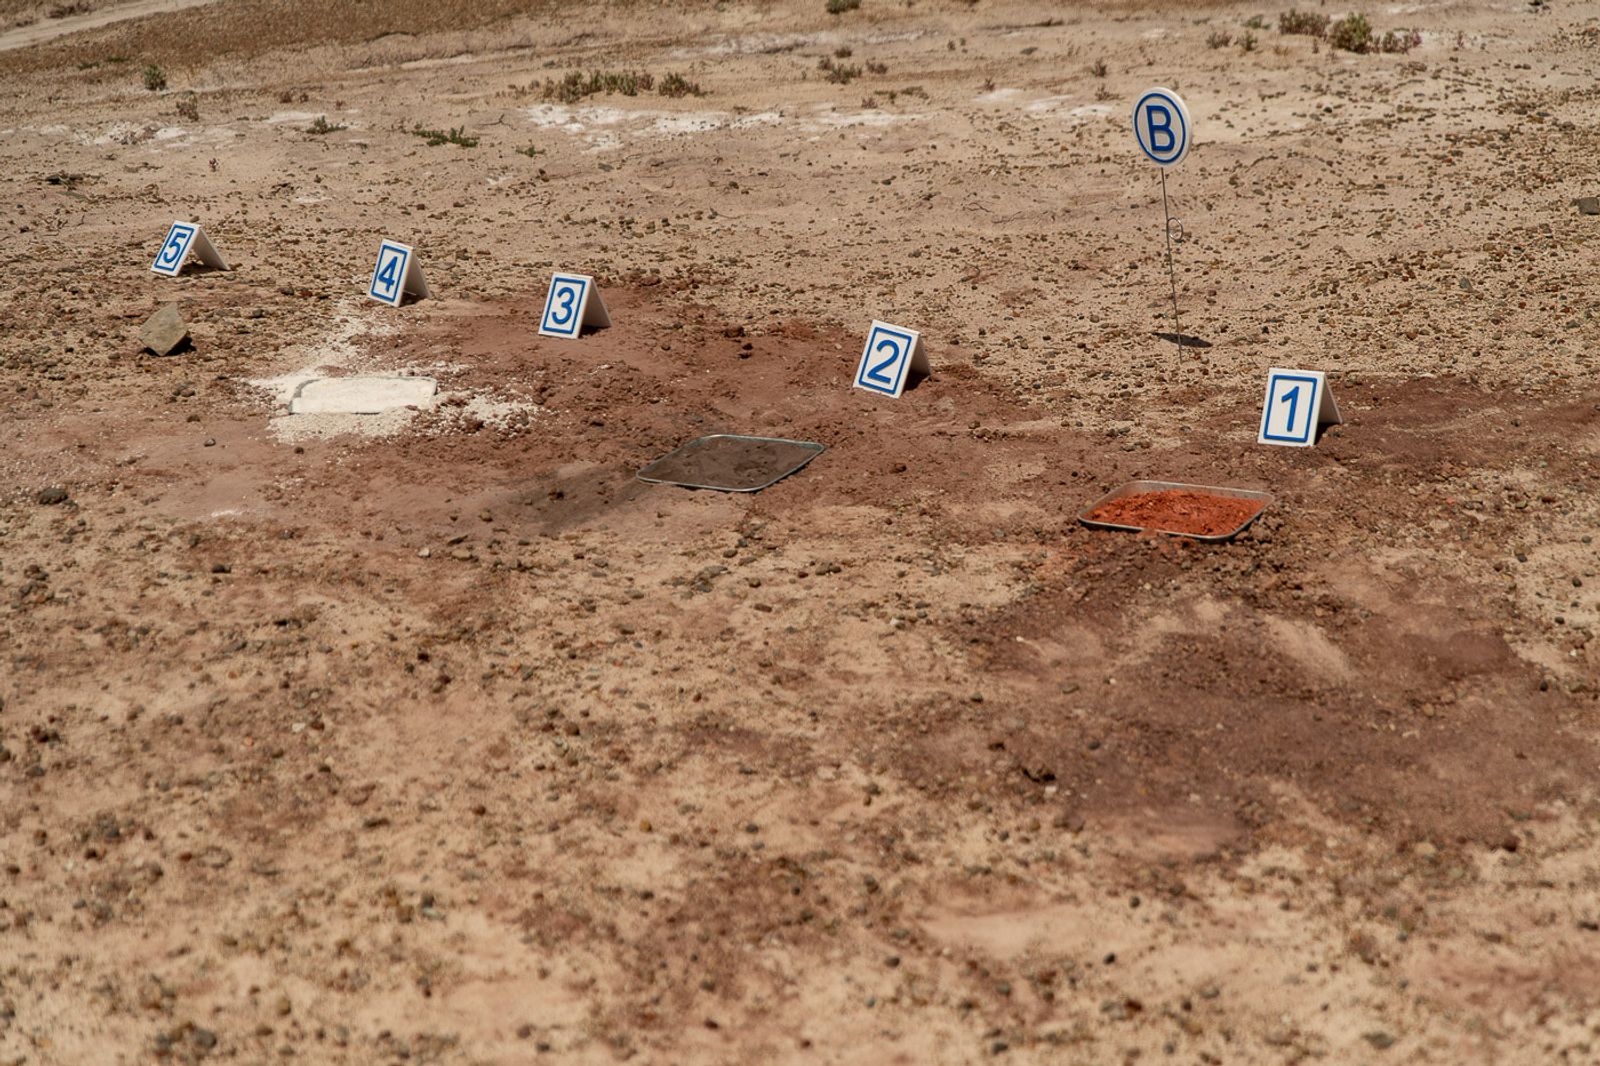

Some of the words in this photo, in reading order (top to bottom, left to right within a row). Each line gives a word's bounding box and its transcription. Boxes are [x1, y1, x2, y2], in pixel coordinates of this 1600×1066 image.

[1146, 104, 1176, 152] B
[162, 231, 188, 264] 5
[377, 256, 397, 292] 4
[551, 287, 575, 325] 3
[867, 339, 900, 384] 2
[1281, 386, 1300, 433] 1
